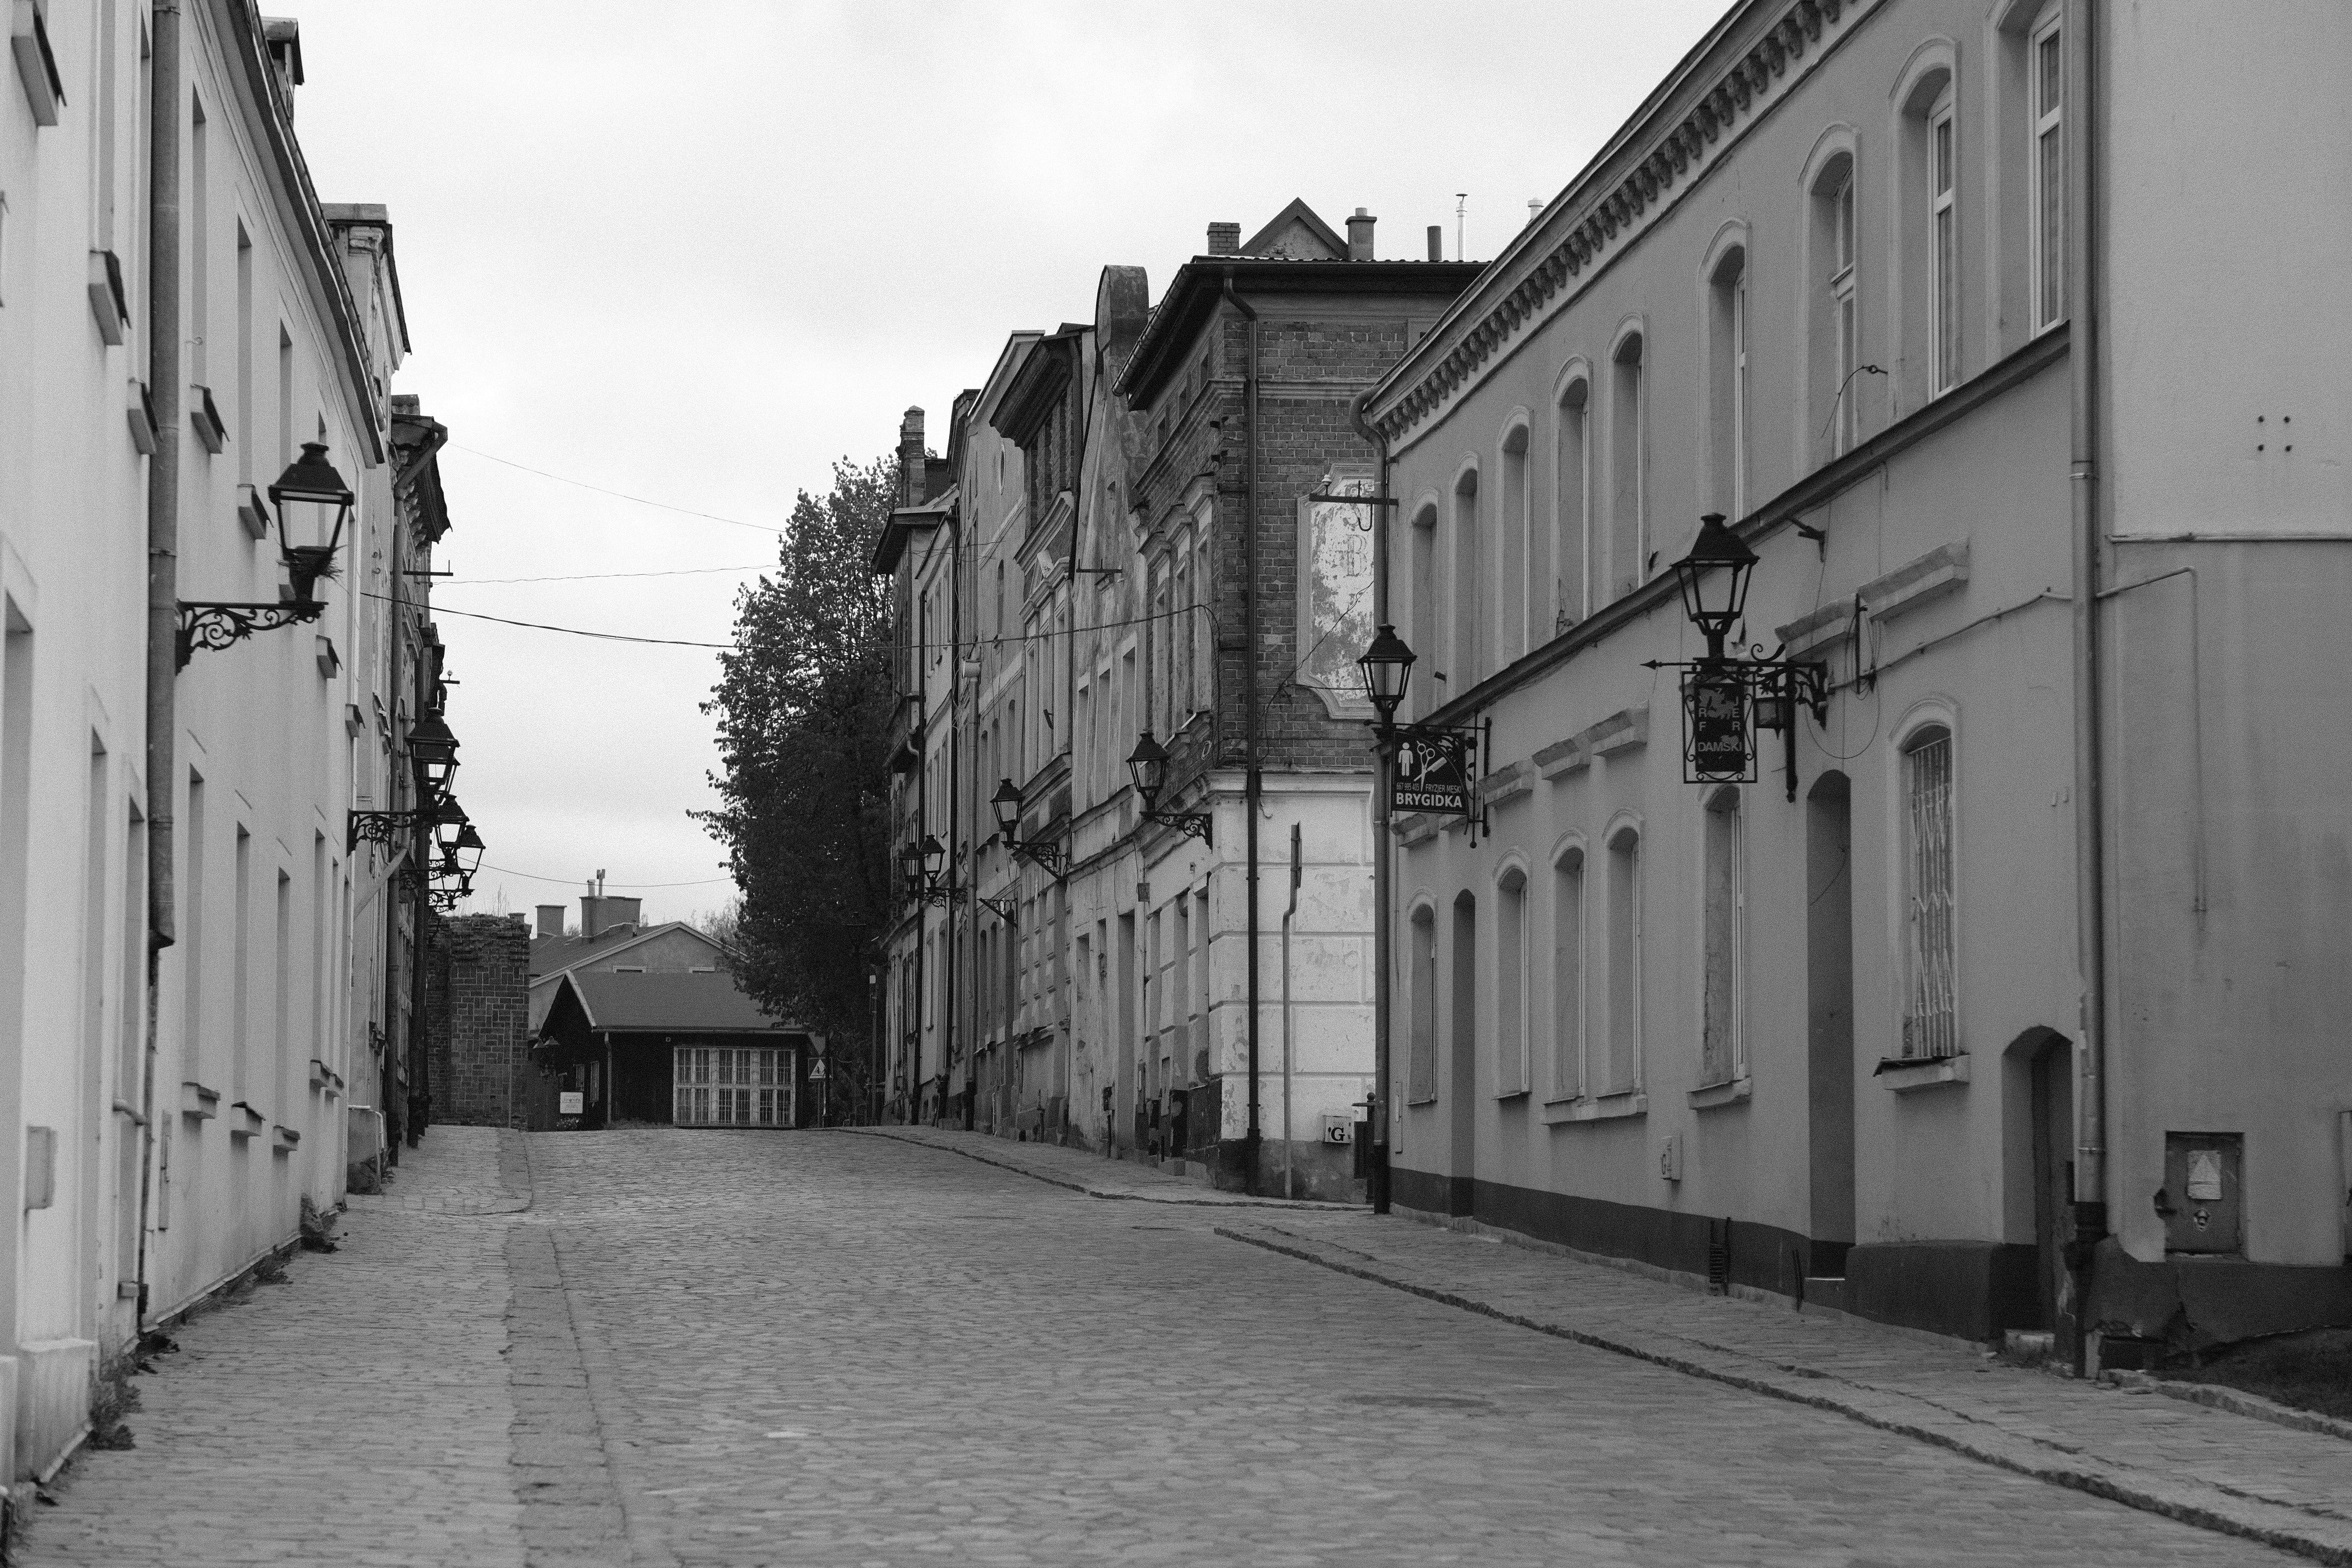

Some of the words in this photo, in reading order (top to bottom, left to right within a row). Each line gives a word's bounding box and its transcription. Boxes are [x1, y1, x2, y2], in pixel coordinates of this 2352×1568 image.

[1698, 741, 1742, 752] DAMSKI
[1425, 784, 1445, 794] FRYZJER
[1396, 793, 1462, 807] BRYGIDKA
[1331, 1127, 1345, 1141] G
